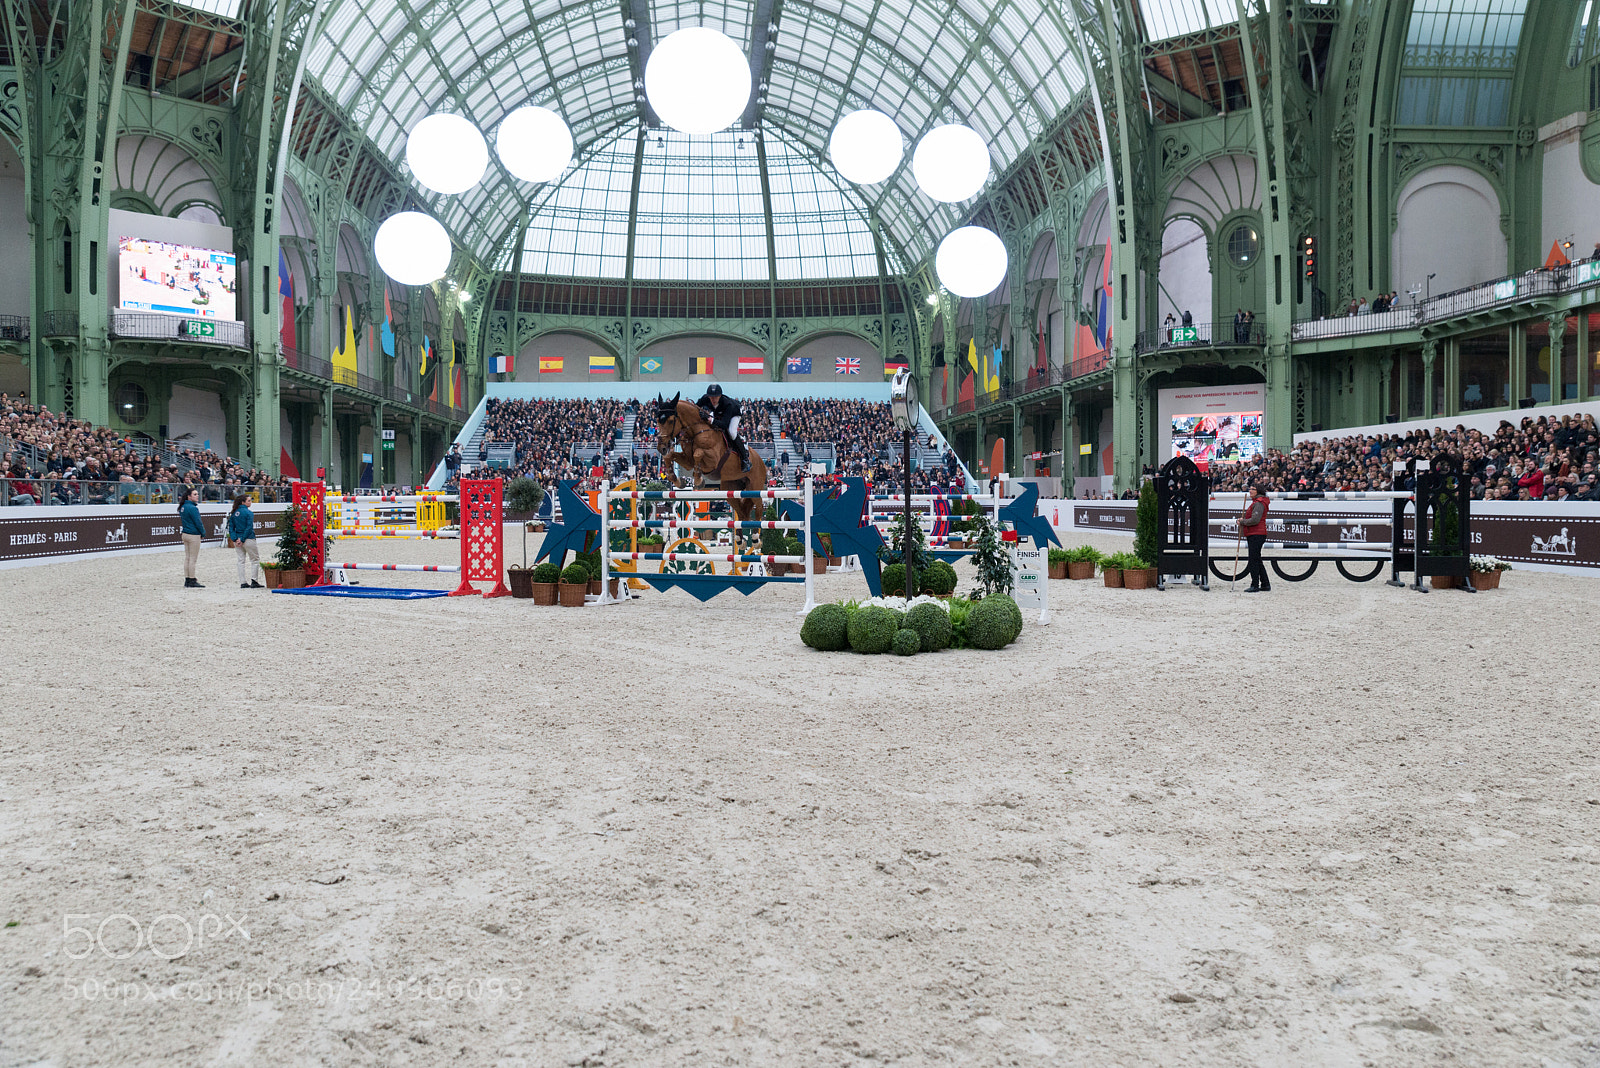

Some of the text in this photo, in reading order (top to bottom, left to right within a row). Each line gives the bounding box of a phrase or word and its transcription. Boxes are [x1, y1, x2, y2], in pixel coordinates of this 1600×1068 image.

[1291, 524, 1312, 534] PARIS
[54, 531, 78, 542] PARIS
[339, 570, 345, 583] 8
